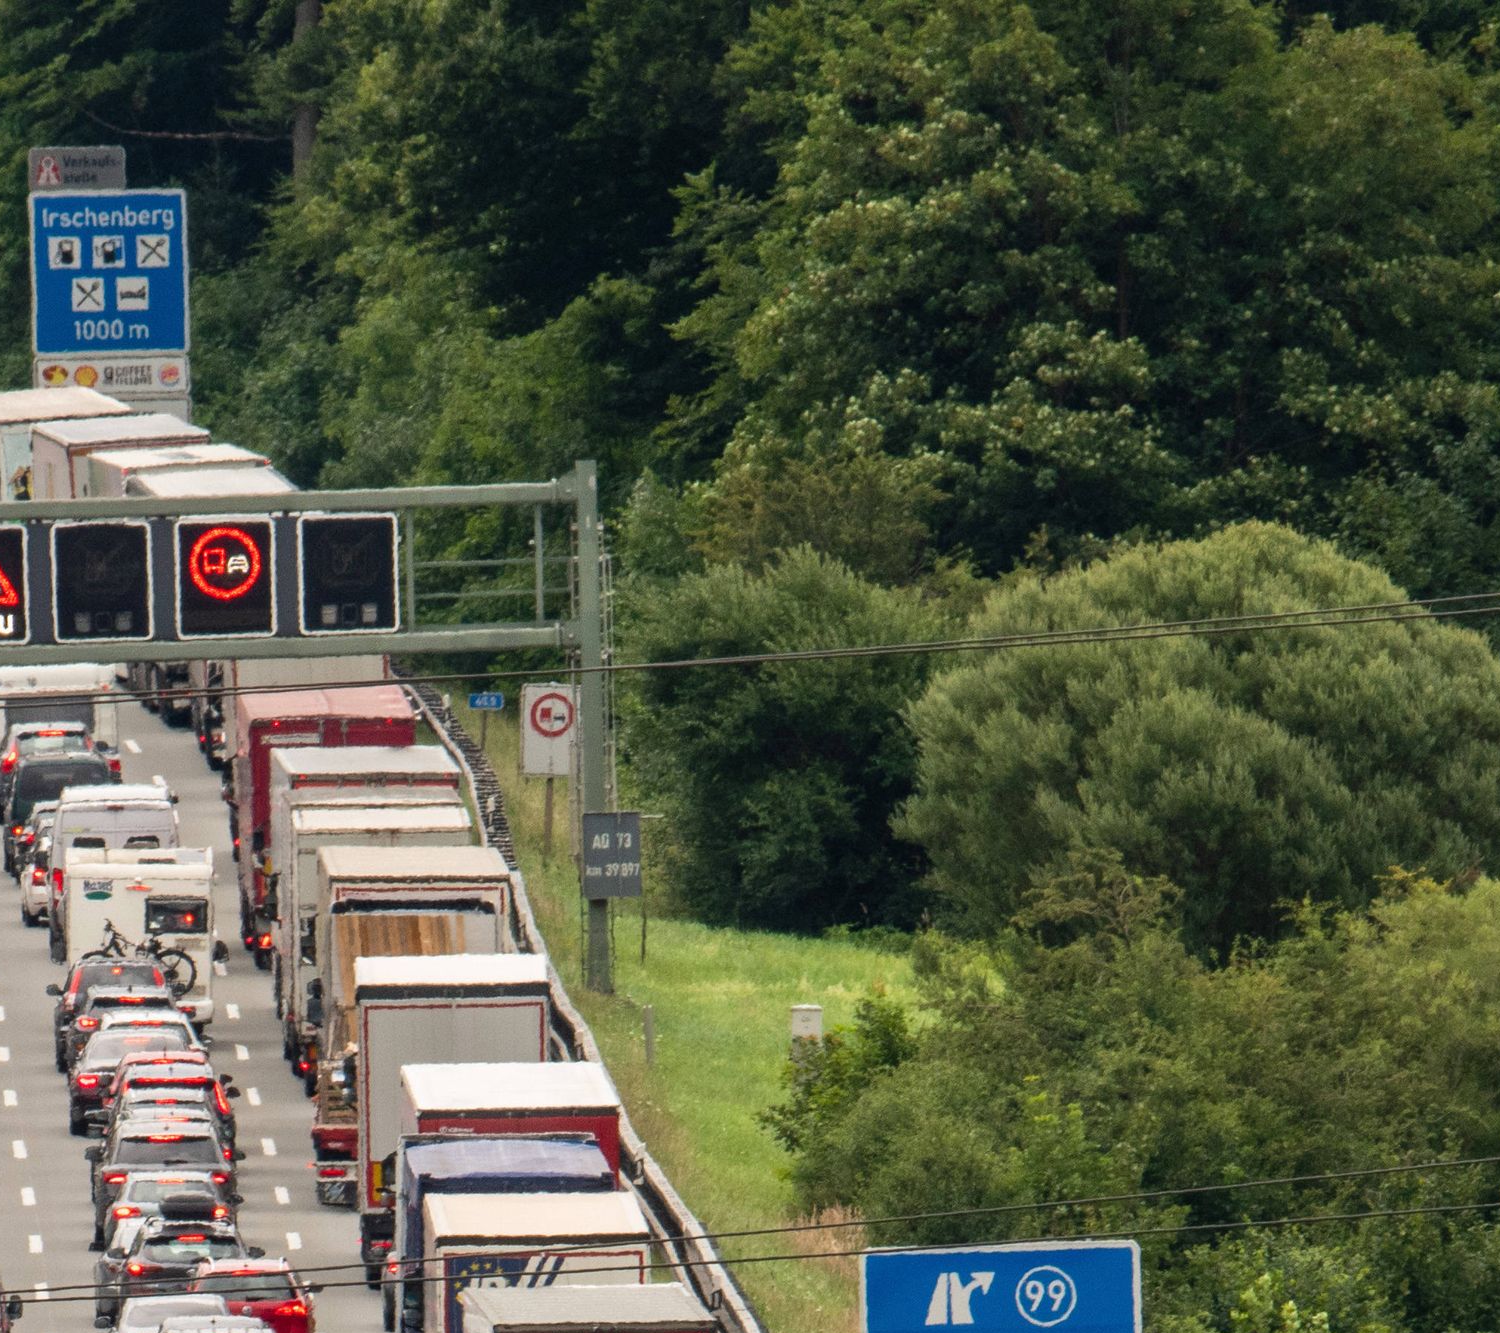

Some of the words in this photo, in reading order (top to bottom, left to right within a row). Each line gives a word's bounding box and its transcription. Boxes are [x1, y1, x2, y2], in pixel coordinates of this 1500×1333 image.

[42, 205, 175, 231] Irschenberg
[73, 319, 124, 341] 1000
[129, 323, 149, 340] m
[1025, 1279, 1067, 1313] 99
